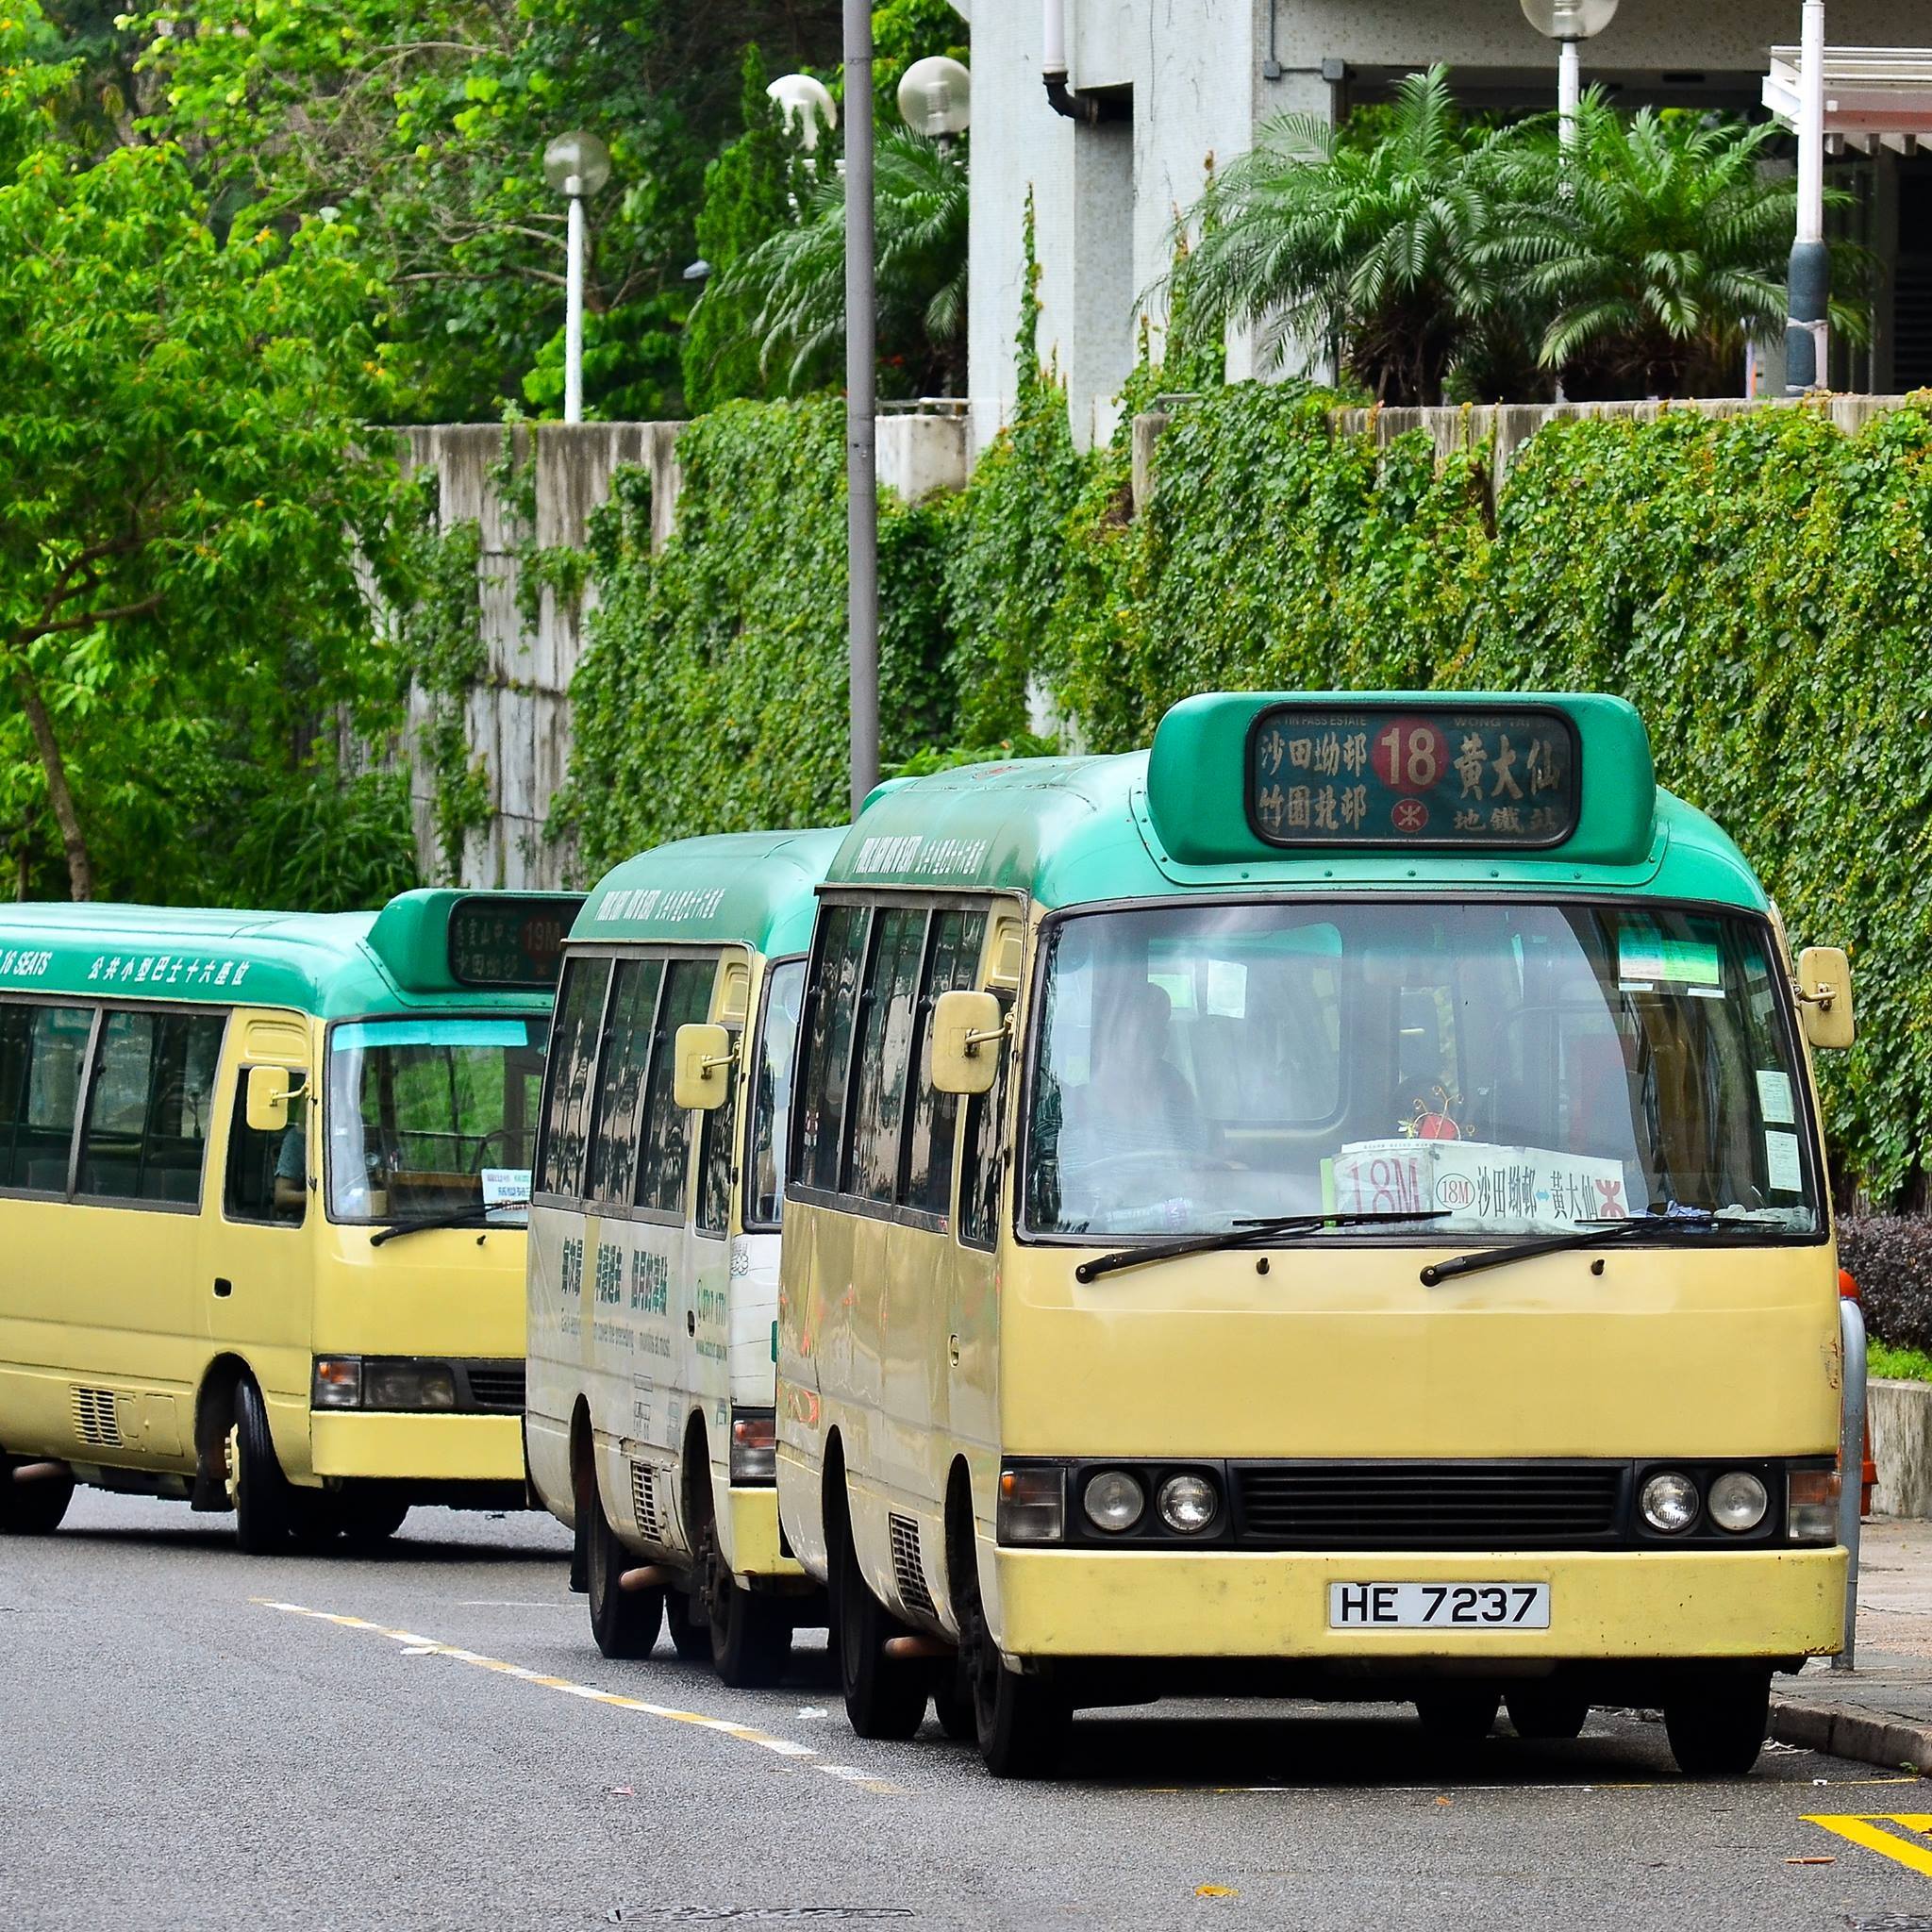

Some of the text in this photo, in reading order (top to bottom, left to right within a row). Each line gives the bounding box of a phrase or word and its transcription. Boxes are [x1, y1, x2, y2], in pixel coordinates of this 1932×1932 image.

[1381, 728, 1436, 785] 18
[13, 951, 53, 975] SEATS
[88, 956, 250, 986] 公共小型巴士十六座位
[1347, 1158, 1421, 1213] 18M
[1442, 1180, 1469, 1204] 18M
[1341, 1588, 1538, 1622] HE 7237
